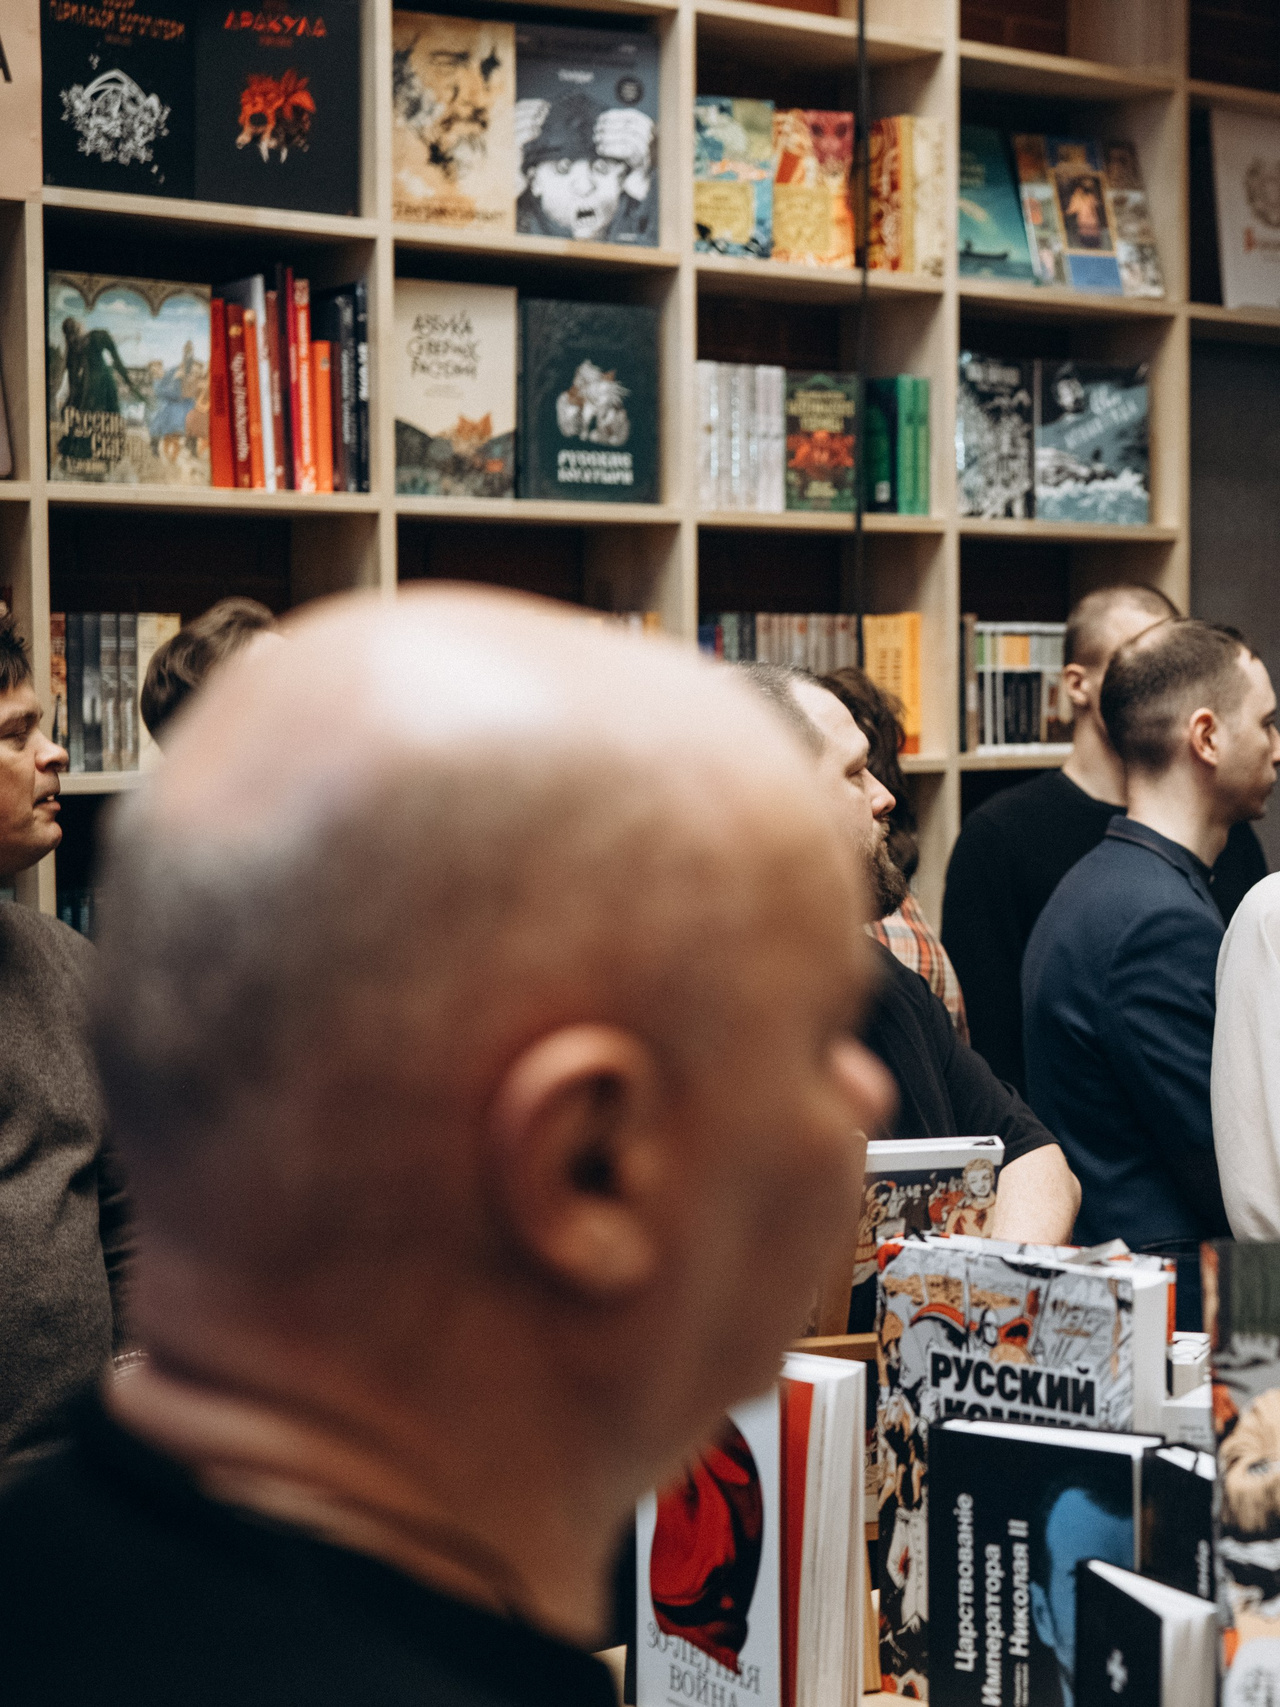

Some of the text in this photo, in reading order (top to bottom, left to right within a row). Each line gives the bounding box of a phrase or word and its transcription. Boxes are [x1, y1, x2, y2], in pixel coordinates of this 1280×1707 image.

[931, 1352, 1096, 1417] РУССКИЙ
[981, 1543, 1005, 1707] Императора
[1009, 1542, 1030, 1657] Николая
